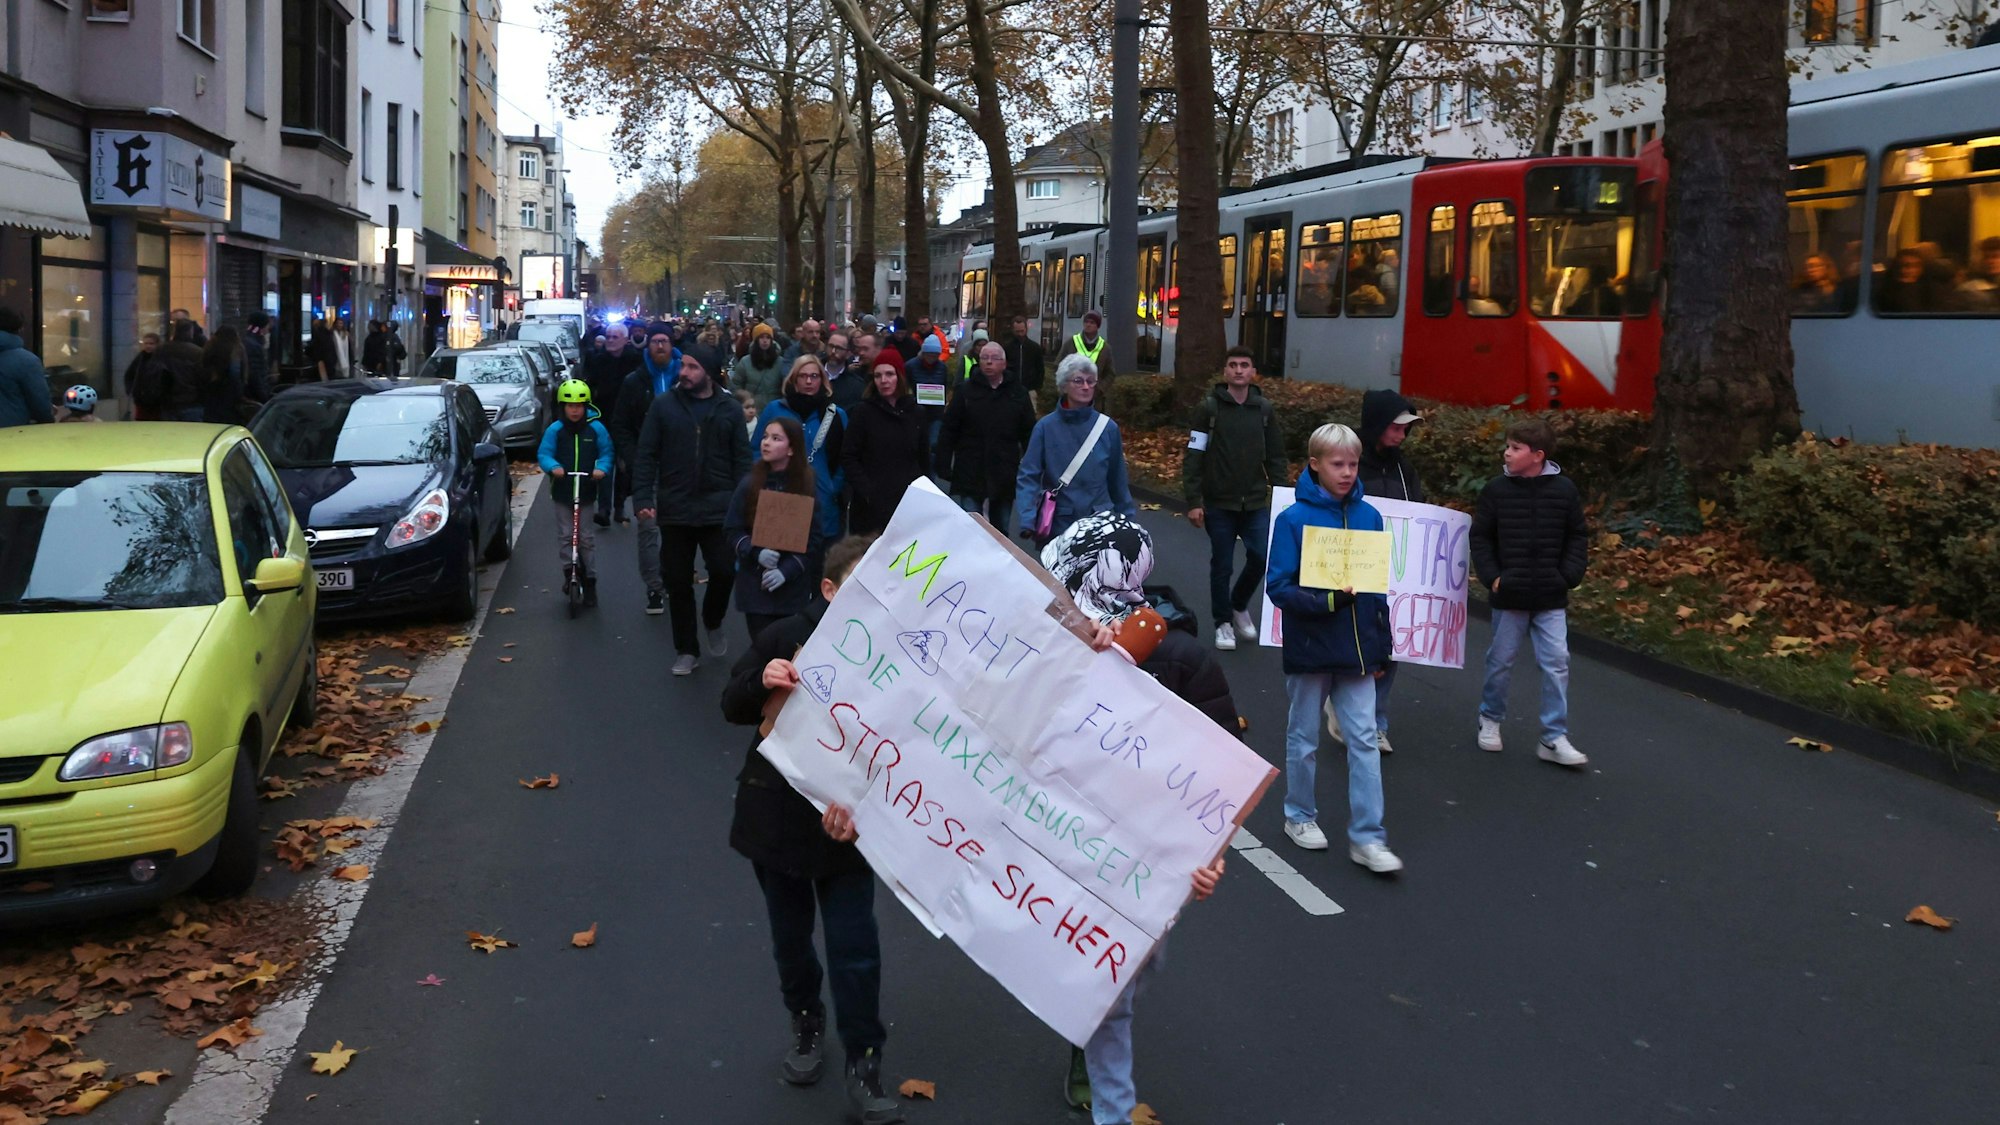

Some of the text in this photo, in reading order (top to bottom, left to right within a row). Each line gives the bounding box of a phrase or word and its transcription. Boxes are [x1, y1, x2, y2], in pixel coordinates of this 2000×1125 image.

[95, 135, 105, 196] TATTOO
[449, 266, 473, 277] KIM
[318, 572, 346, 586] 390
[1415, 517, 1468, 591] TAG
[1388, 591, 1466, 666] GEFAHR
[889, 539, 1236, 835] MACHT FÜR UNS
[832, 619, 1151, 900] DIE LUXEMBURGER
[817, 702, 1126, 984] STRASSE SICHER
